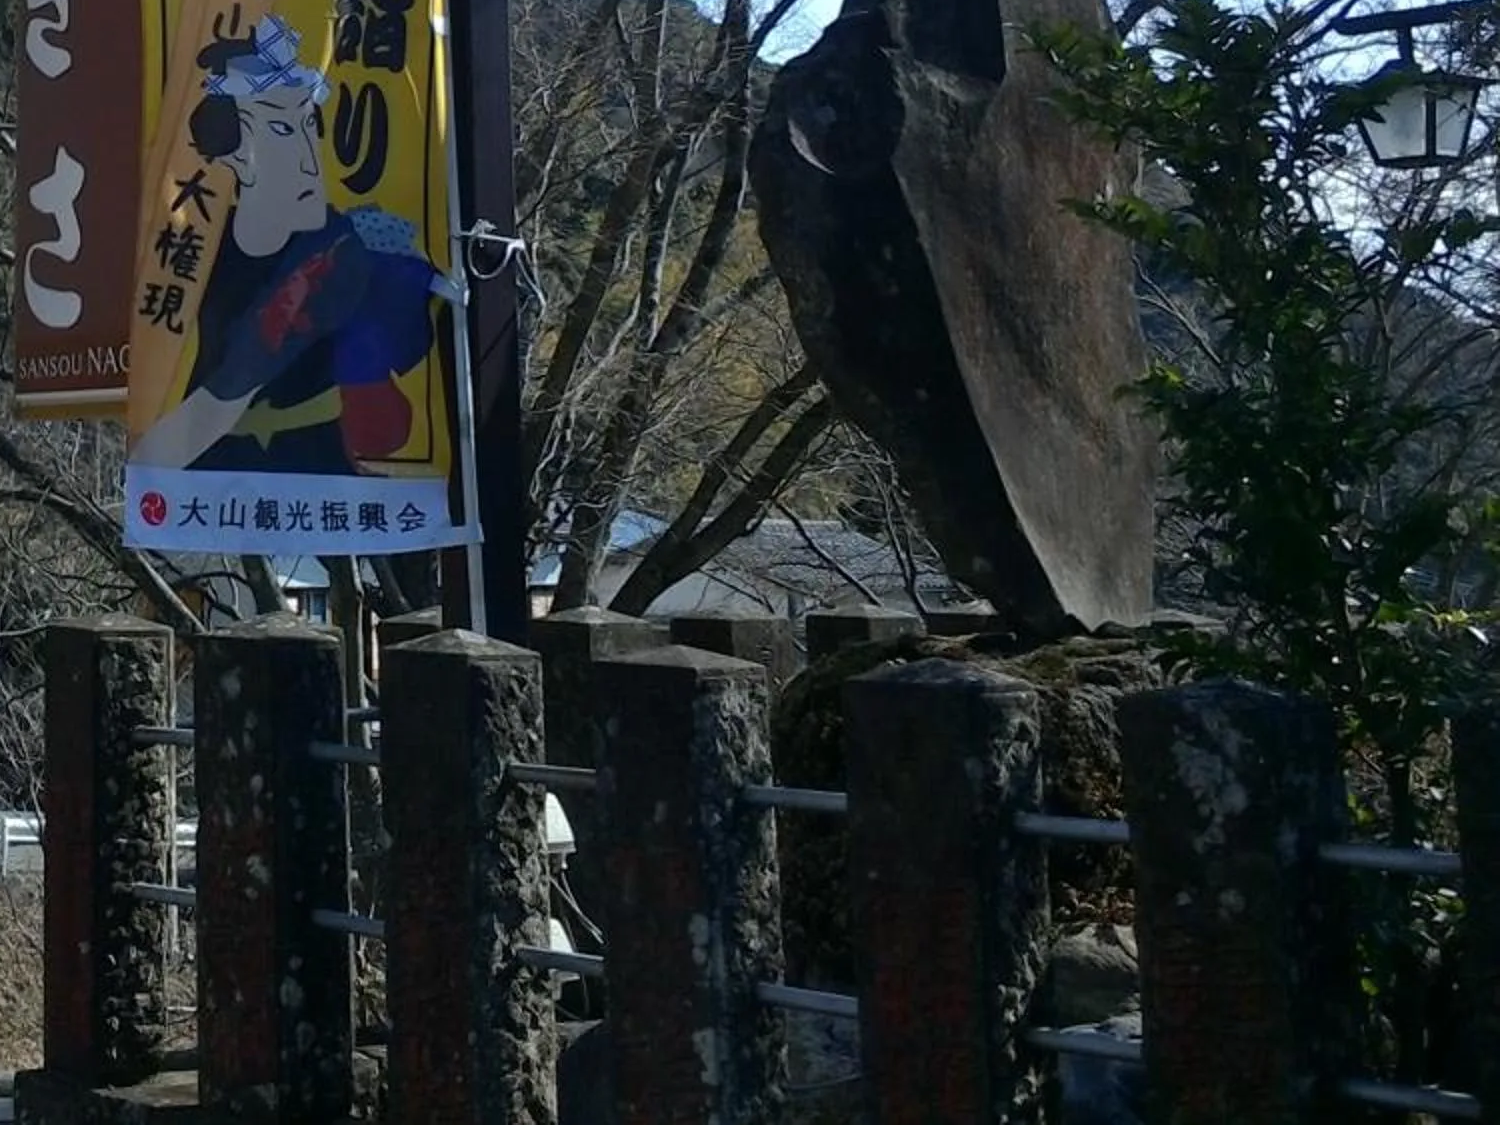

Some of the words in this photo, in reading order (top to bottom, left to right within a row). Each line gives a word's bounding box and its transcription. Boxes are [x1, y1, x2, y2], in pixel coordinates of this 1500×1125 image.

[19, 352, 83, 379] SANSOU
[179, 496, 427, 533] 大山観光振興会
